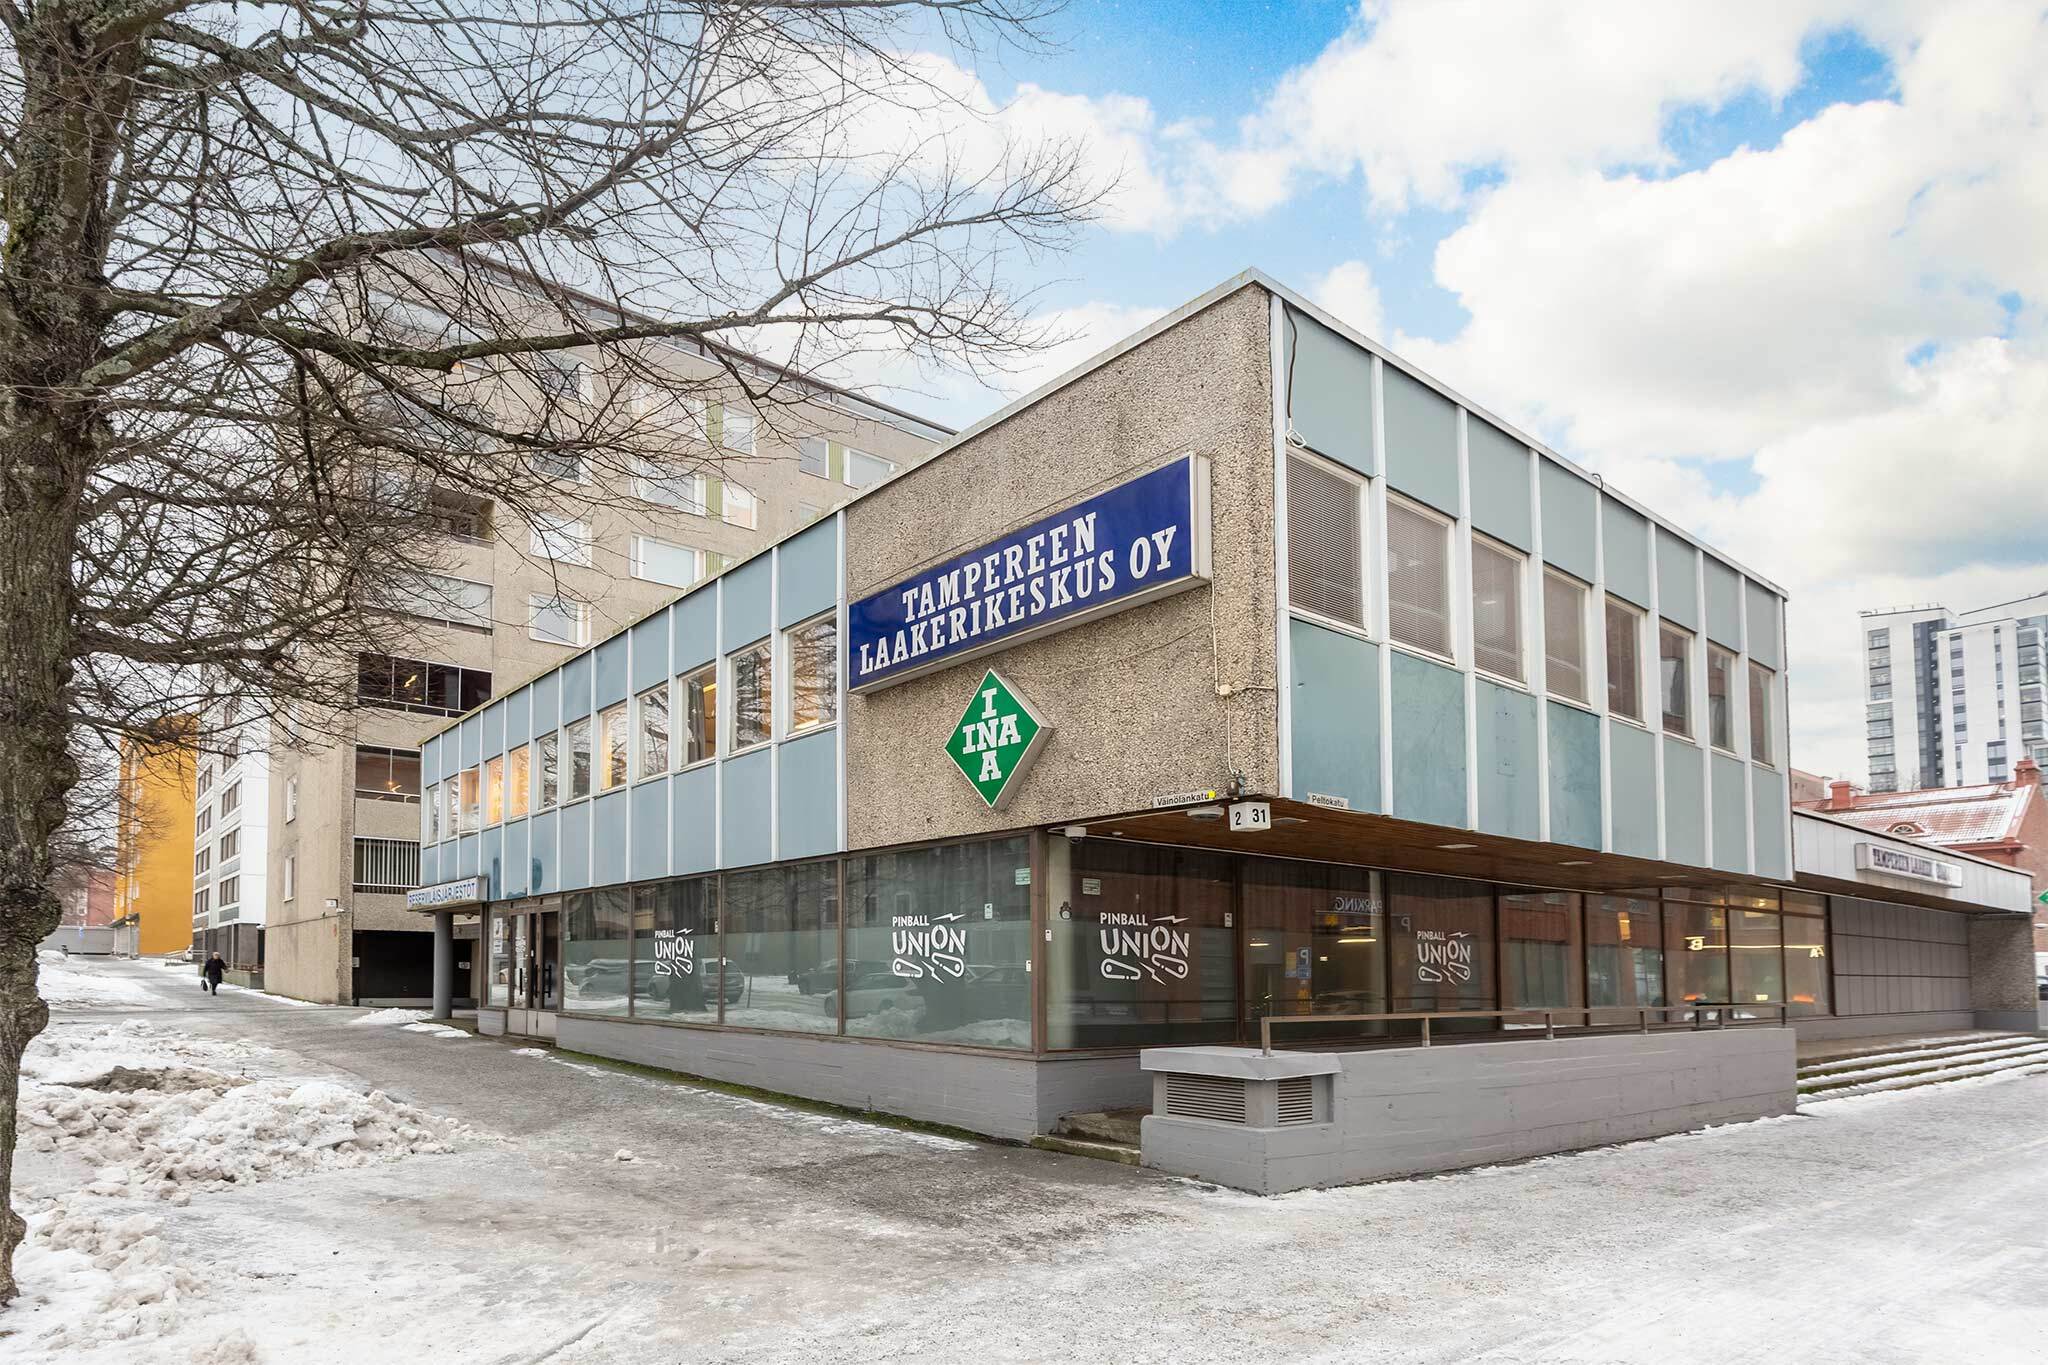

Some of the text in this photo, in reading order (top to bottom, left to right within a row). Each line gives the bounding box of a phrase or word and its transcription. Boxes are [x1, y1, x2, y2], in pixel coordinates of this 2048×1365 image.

[902, 511, 1097, 623] TAMPEREEN
[859, 525, 1177, 675] LAAKERIKESKUS OY
[962, 713, 1021, 755] INA
[1312, 794, 1345, 808] Peltokatu
[1235, 811, 1242, 826] 2
[1252, 808, 1267, 823] 31
[892, 914, 930, 927] PINBALL
[1100, 912, 1148, 926] PINBALL
[655, 929, 675, 939] PINBALL
[892, 924, 967, 957] UNION
[1100, 925, 1190, 959] UNION
[1417, 930, 1446, 940] PINBALL
[655, 936, 694, 960] UNION
[1417, 940, 1471, 965] UNION
